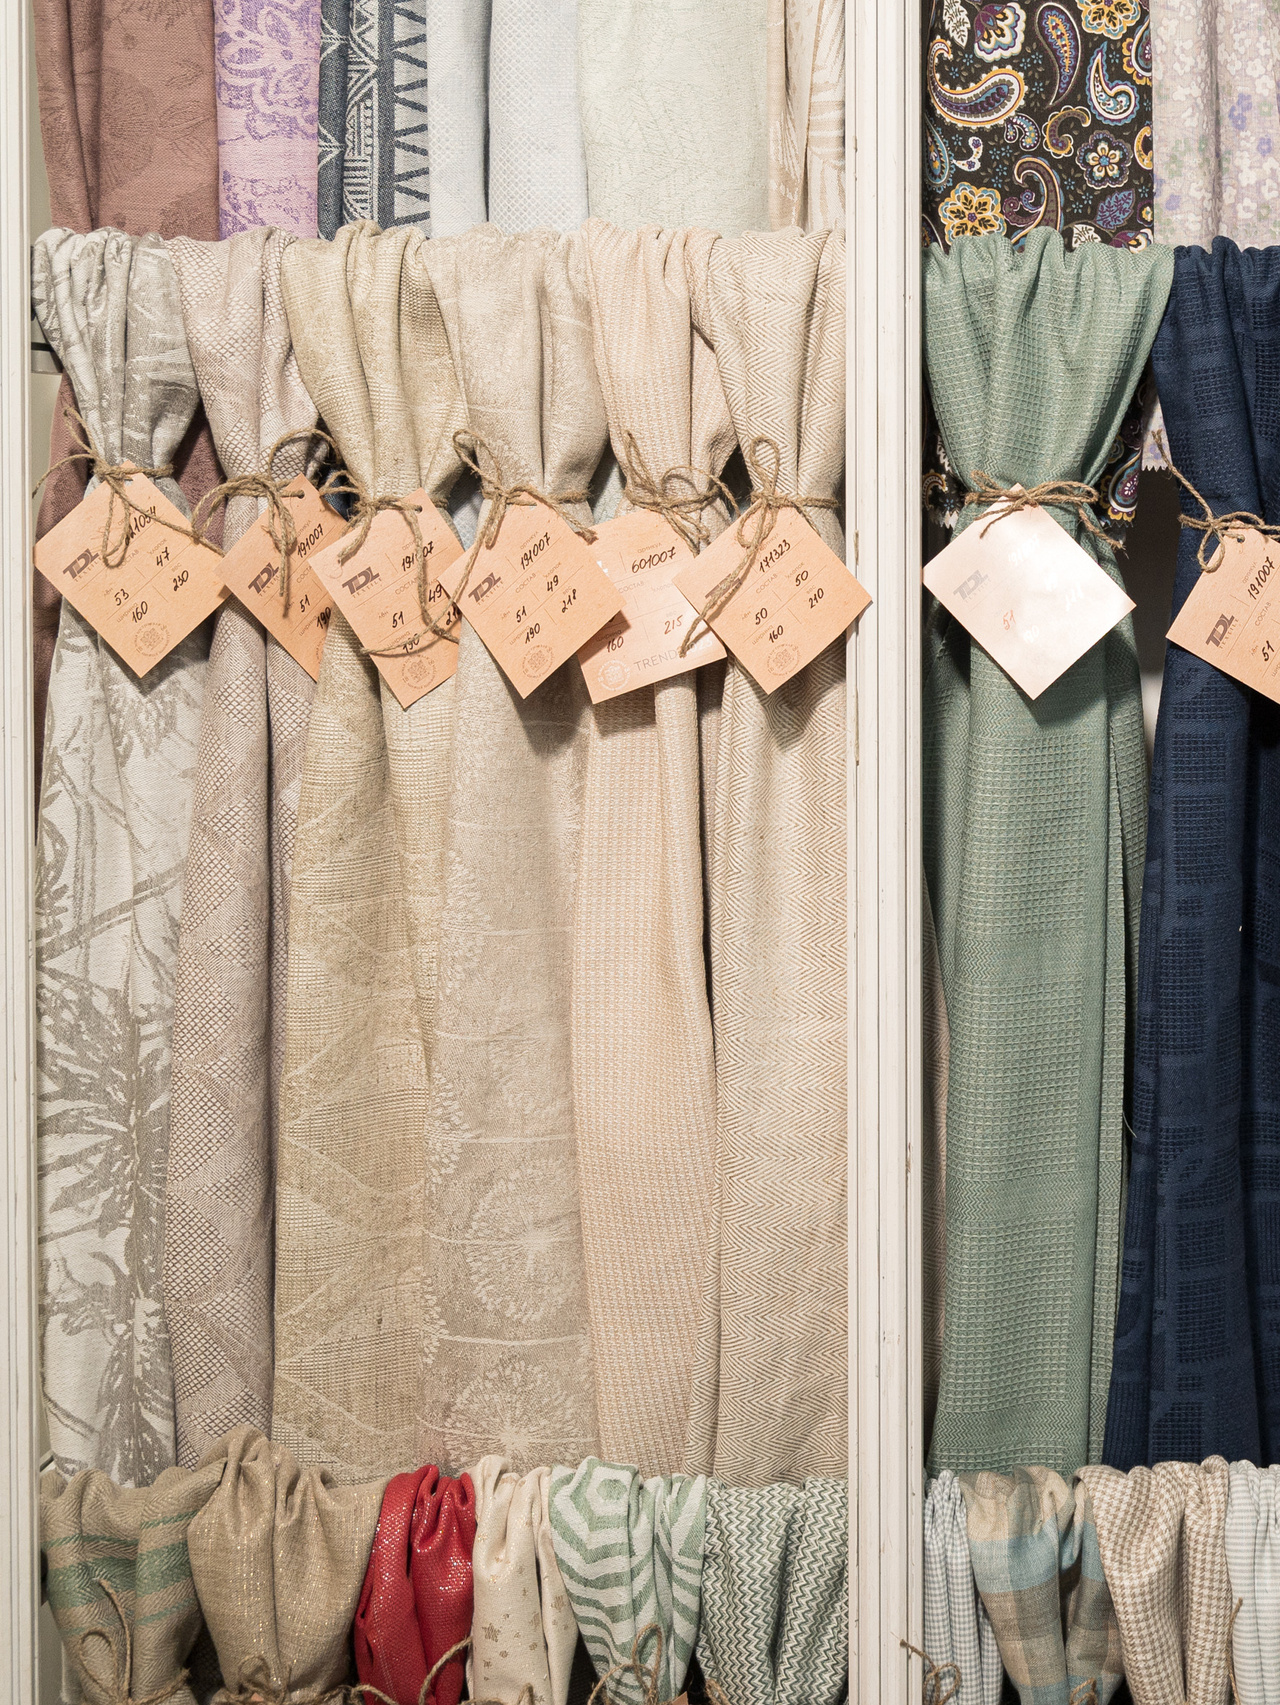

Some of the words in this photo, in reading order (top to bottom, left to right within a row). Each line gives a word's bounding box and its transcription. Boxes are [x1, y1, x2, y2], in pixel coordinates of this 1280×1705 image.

[297, 523, 324, 558] 191007
[521, 532, 551, 570] 191007
[63, 548, 100, 579] TDL
[156, 547, 170, 567] 47
[401, 541, 434, 572] 19107
[631, 546, 676, 574] 601007
[758, 539, 791, 573] 171323
[173, 570, 189, 591] 230
[248, 562, 280, 594] TDL
[296, 565, 312, 584] СОСТА
[341, 566, 380, 595] TDL
[515, 572, 536, 593] СОСТАВ
[546, 574, 559, 592] 49
[756, 573, 778, 594] СОСТАВ
[795, 570, 809, 587] 50
[953, 569, 989, 600] TDL
[1247, 556, 1275, 600] 191007
[114, 588, 129, 606] 53
[428, 583, 443, 603] 49
[468, 572, 501, 603] TDL
[808, 587, 824, 609] 210
[300, 594, 310, 613] 51
[561, 588, 577, 613] 218
[132, 601, 148, 623] 160
[316, 606, 332, 629] 190
[392, 611, 404, 629] 51
[516, 605, 527, 623] 51
[755, 607, 768, 626] 50
[1003, 609, 1015, 630] 51
[1254, 602, 1272, 627] СОСТАВ
[525, 622, 541, 644] 190
[664, 615, 683, 635] 215
[768, 625, 784, 643] 160
[1205, 613, 1235, 647] TDL
[607, 635, 624, 653] 160
[1261, 640, 1275, 662] 51
